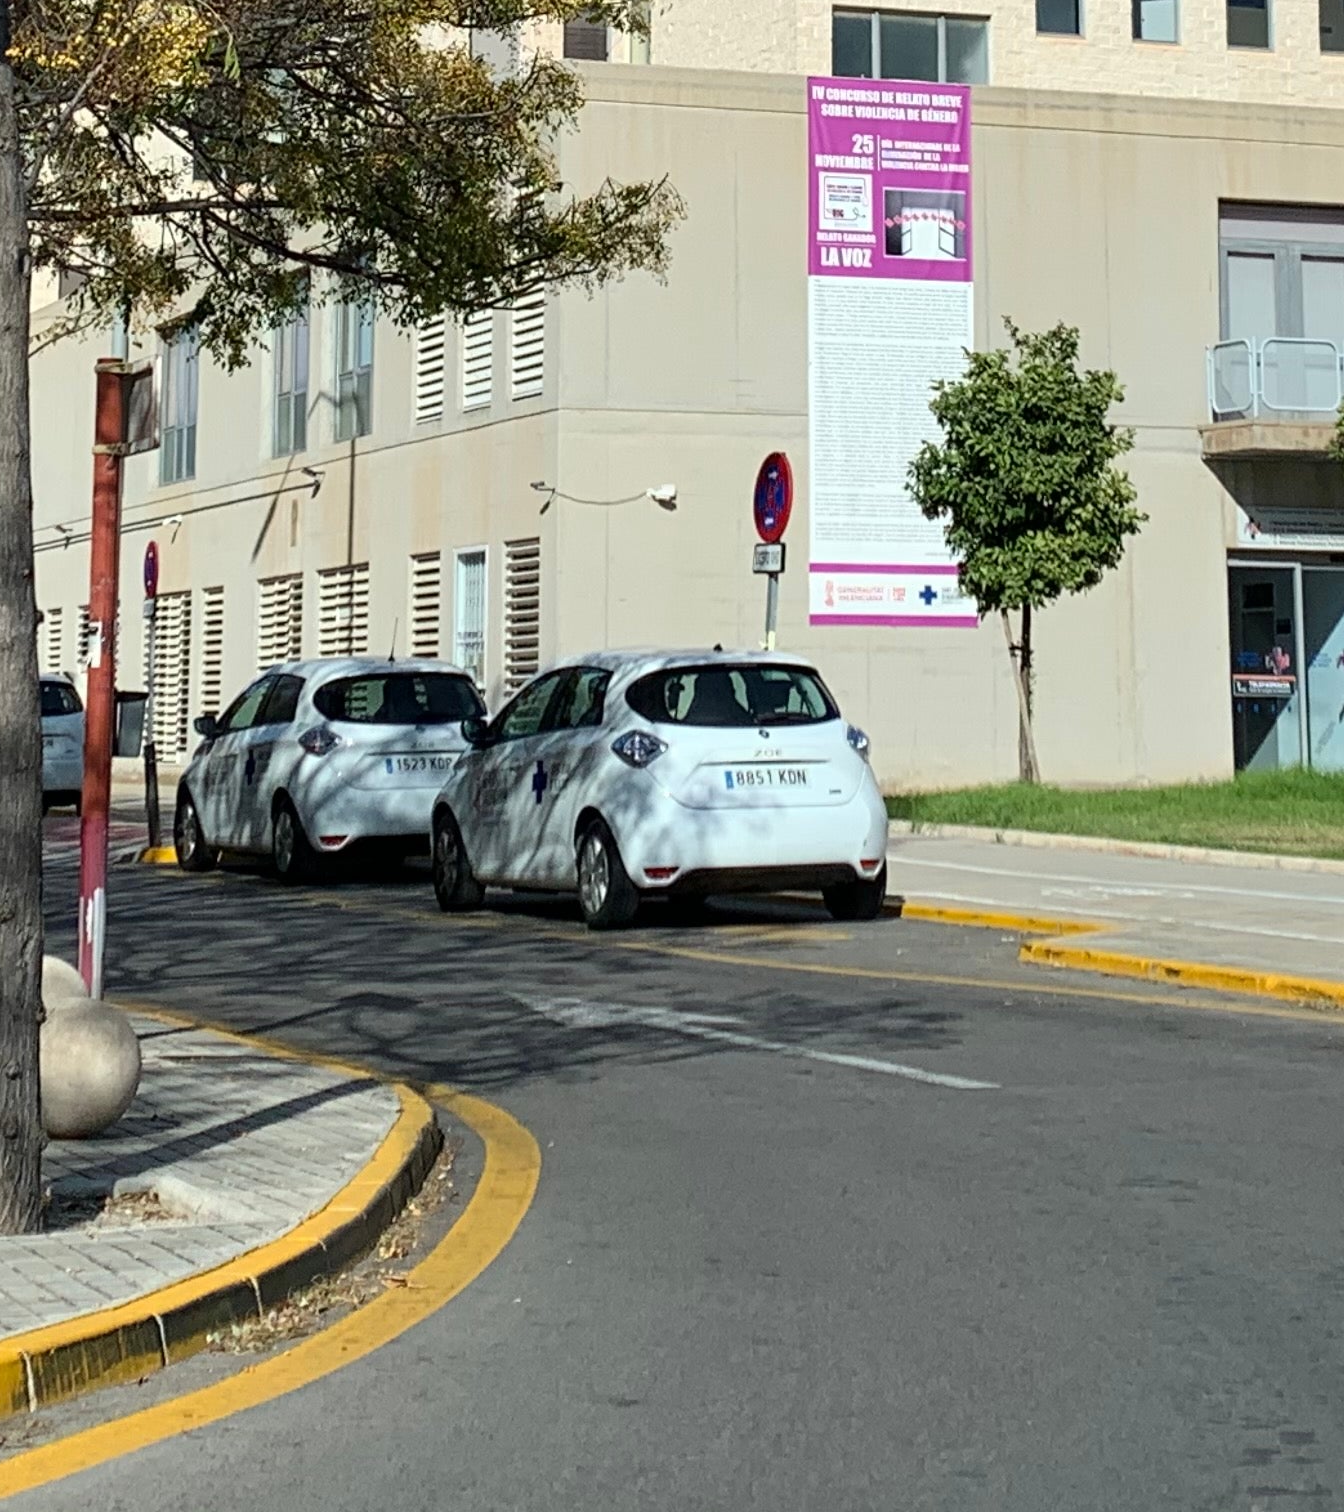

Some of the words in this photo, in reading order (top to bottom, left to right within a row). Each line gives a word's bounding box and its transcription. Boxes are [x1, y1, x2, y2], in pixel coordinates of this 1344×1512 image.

[812, 85, 825, 100] IV
[826, 87, 880, 104] CONCURSO
[881, 91, 895, 105] DE
[895, 91, 930, 106] RELATO
[932, 93, 963, 108] BREVE
[820, 103, 854, 117] SOBRE
[855, 105, 906, 121] VIOLENCIA
[907, 108, 920, 122] DE
[921, 108, 958, 124] GÉNERO
[851, 133, 874, 154] 25
[815, 154, 874, 170] NOVIEMBRE
[820, 246, 841, 266] LA
[841, 247, 873, 268] VOZ
[397, 757, 427, 771] 1523
[736, 770, 773, 786] 8851
[778, 769, 807, 785] KDN
